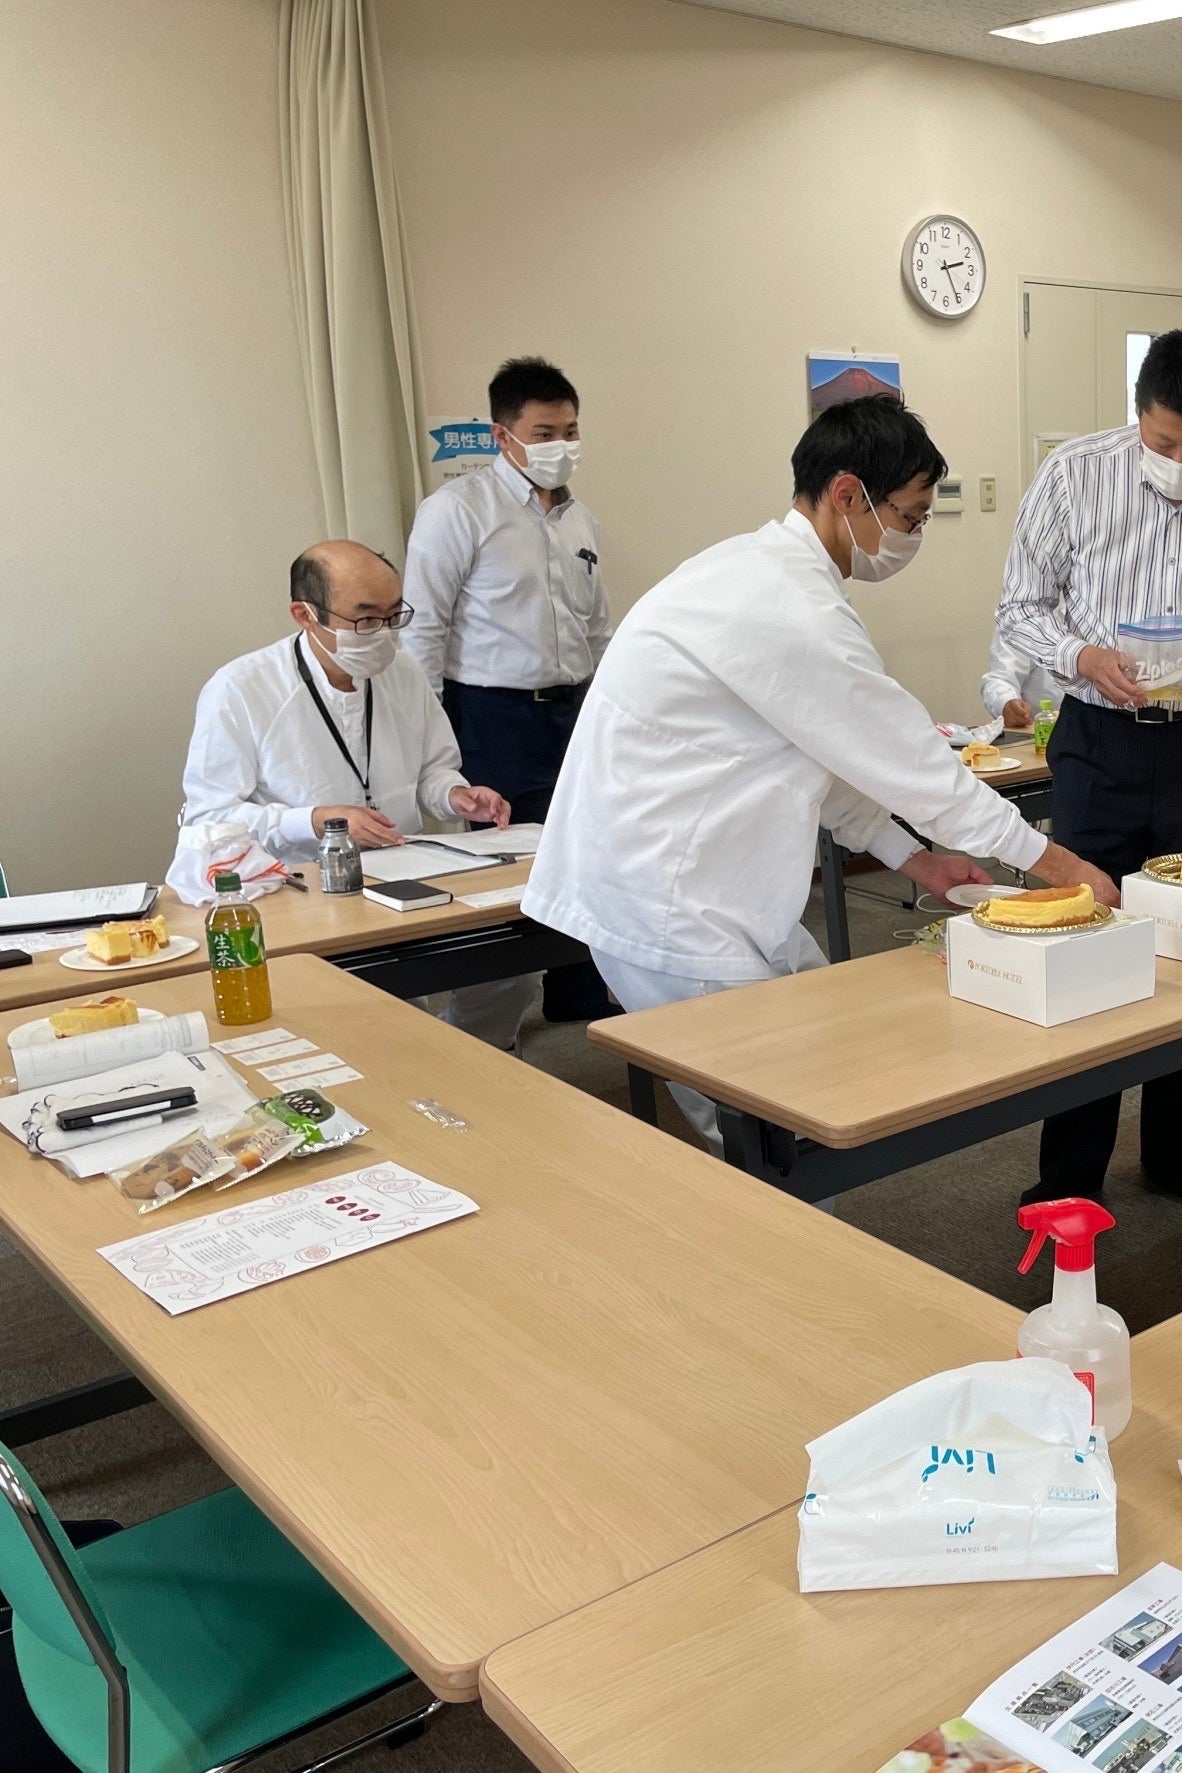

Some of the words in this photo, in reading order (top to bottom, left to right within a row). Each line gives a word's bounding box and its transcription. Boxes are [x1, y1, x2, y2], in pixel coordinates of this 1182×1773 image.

[929, 230, 937, 242] 11
[941, 227, 950, 239] 12
[957, 234, 960, 245] 1
[920, 243, 928, 255] 10
[964, 247, 970, 258] 2
[917, 259, 923, 271] 9
[968, 265, 974, 276] 3
[921, 277, 927, 288] 8
[964, 282, 971, 293] 4
[931, 290, 937, 302] 7
[943, 296, 949, 307] 6
[444, 431, 500, 450] 男性専
[214, 934, 235, 967] 生茶
[947, 1517, 974, 1535] Livi
